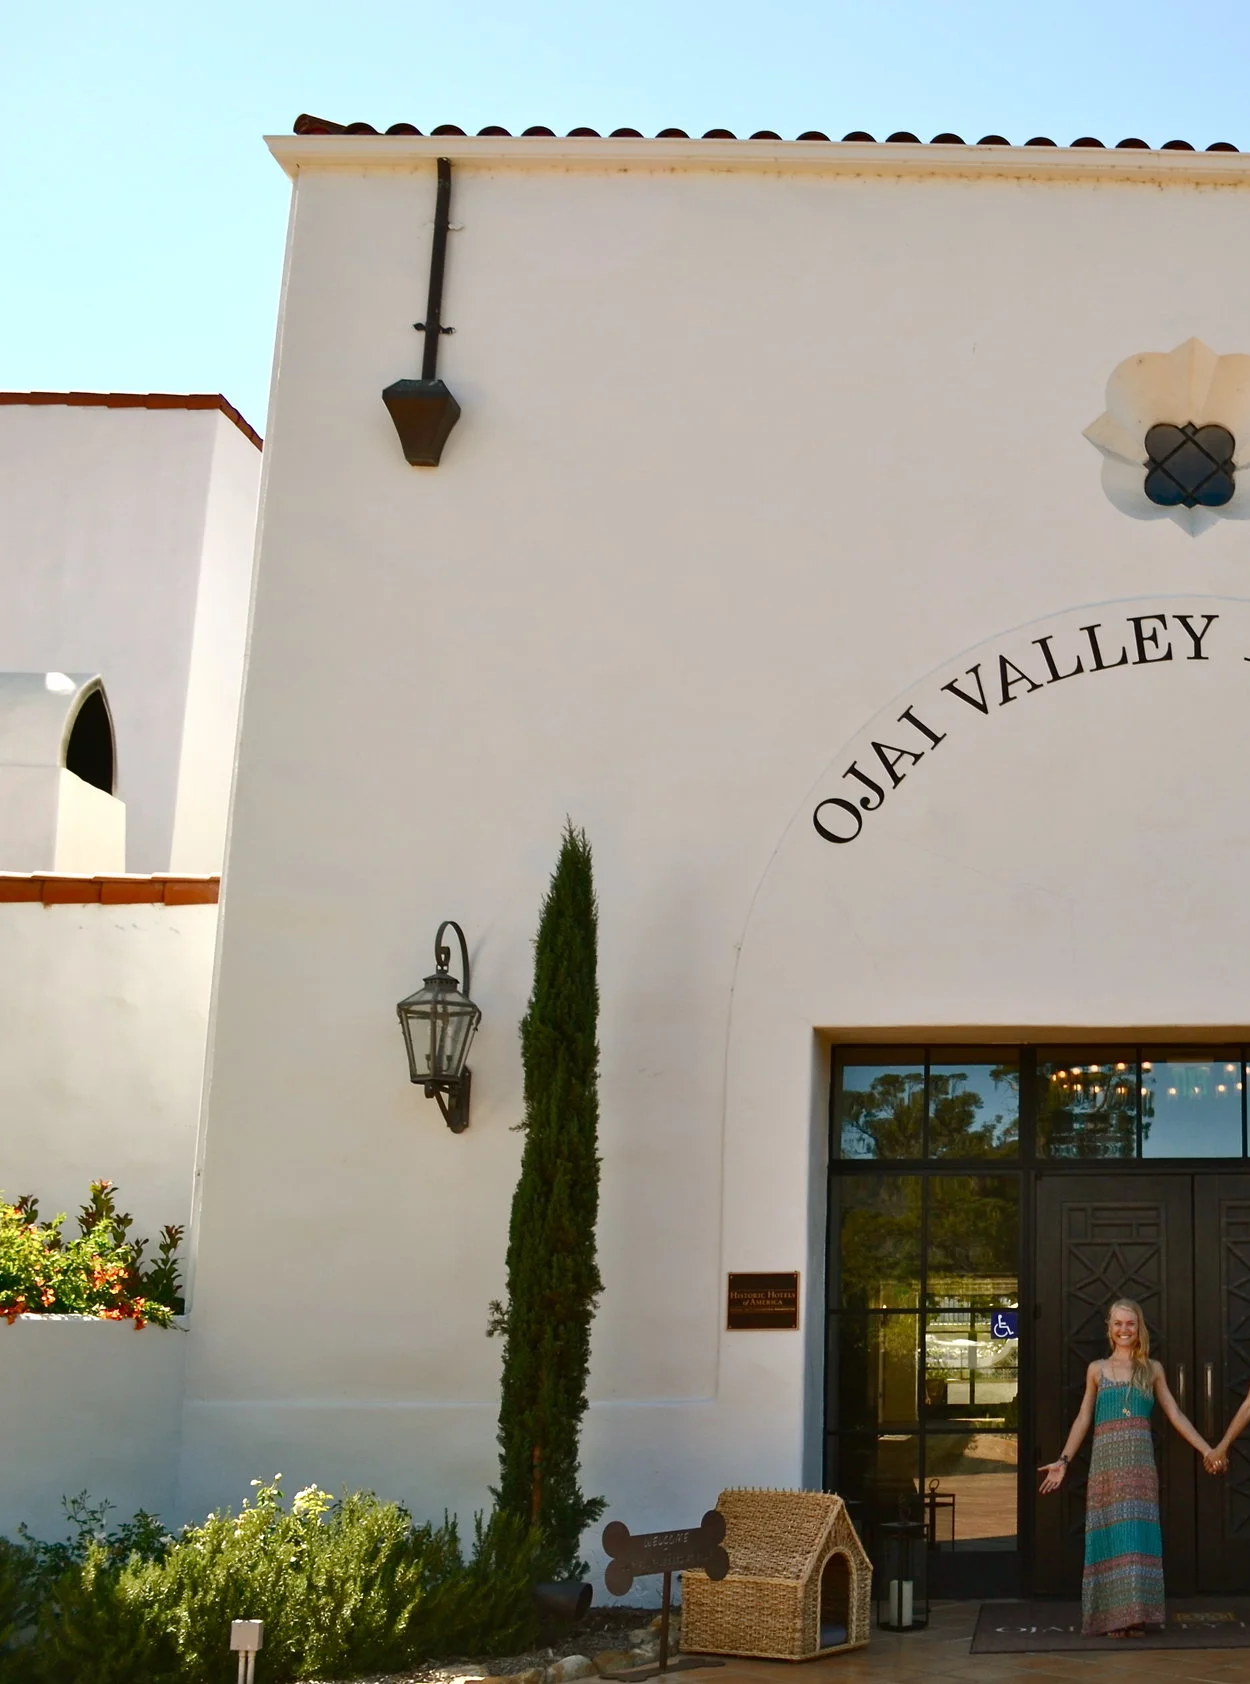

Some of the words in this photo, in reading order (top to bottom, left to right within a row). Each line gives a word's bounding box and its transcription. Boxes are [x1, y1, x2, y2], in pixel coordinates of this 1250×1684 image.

[813, 705, 947, 844] OJAI
[940, 613, 1220, 715] VALLEY
[644, 1532, 690, 1549] WELCOME
